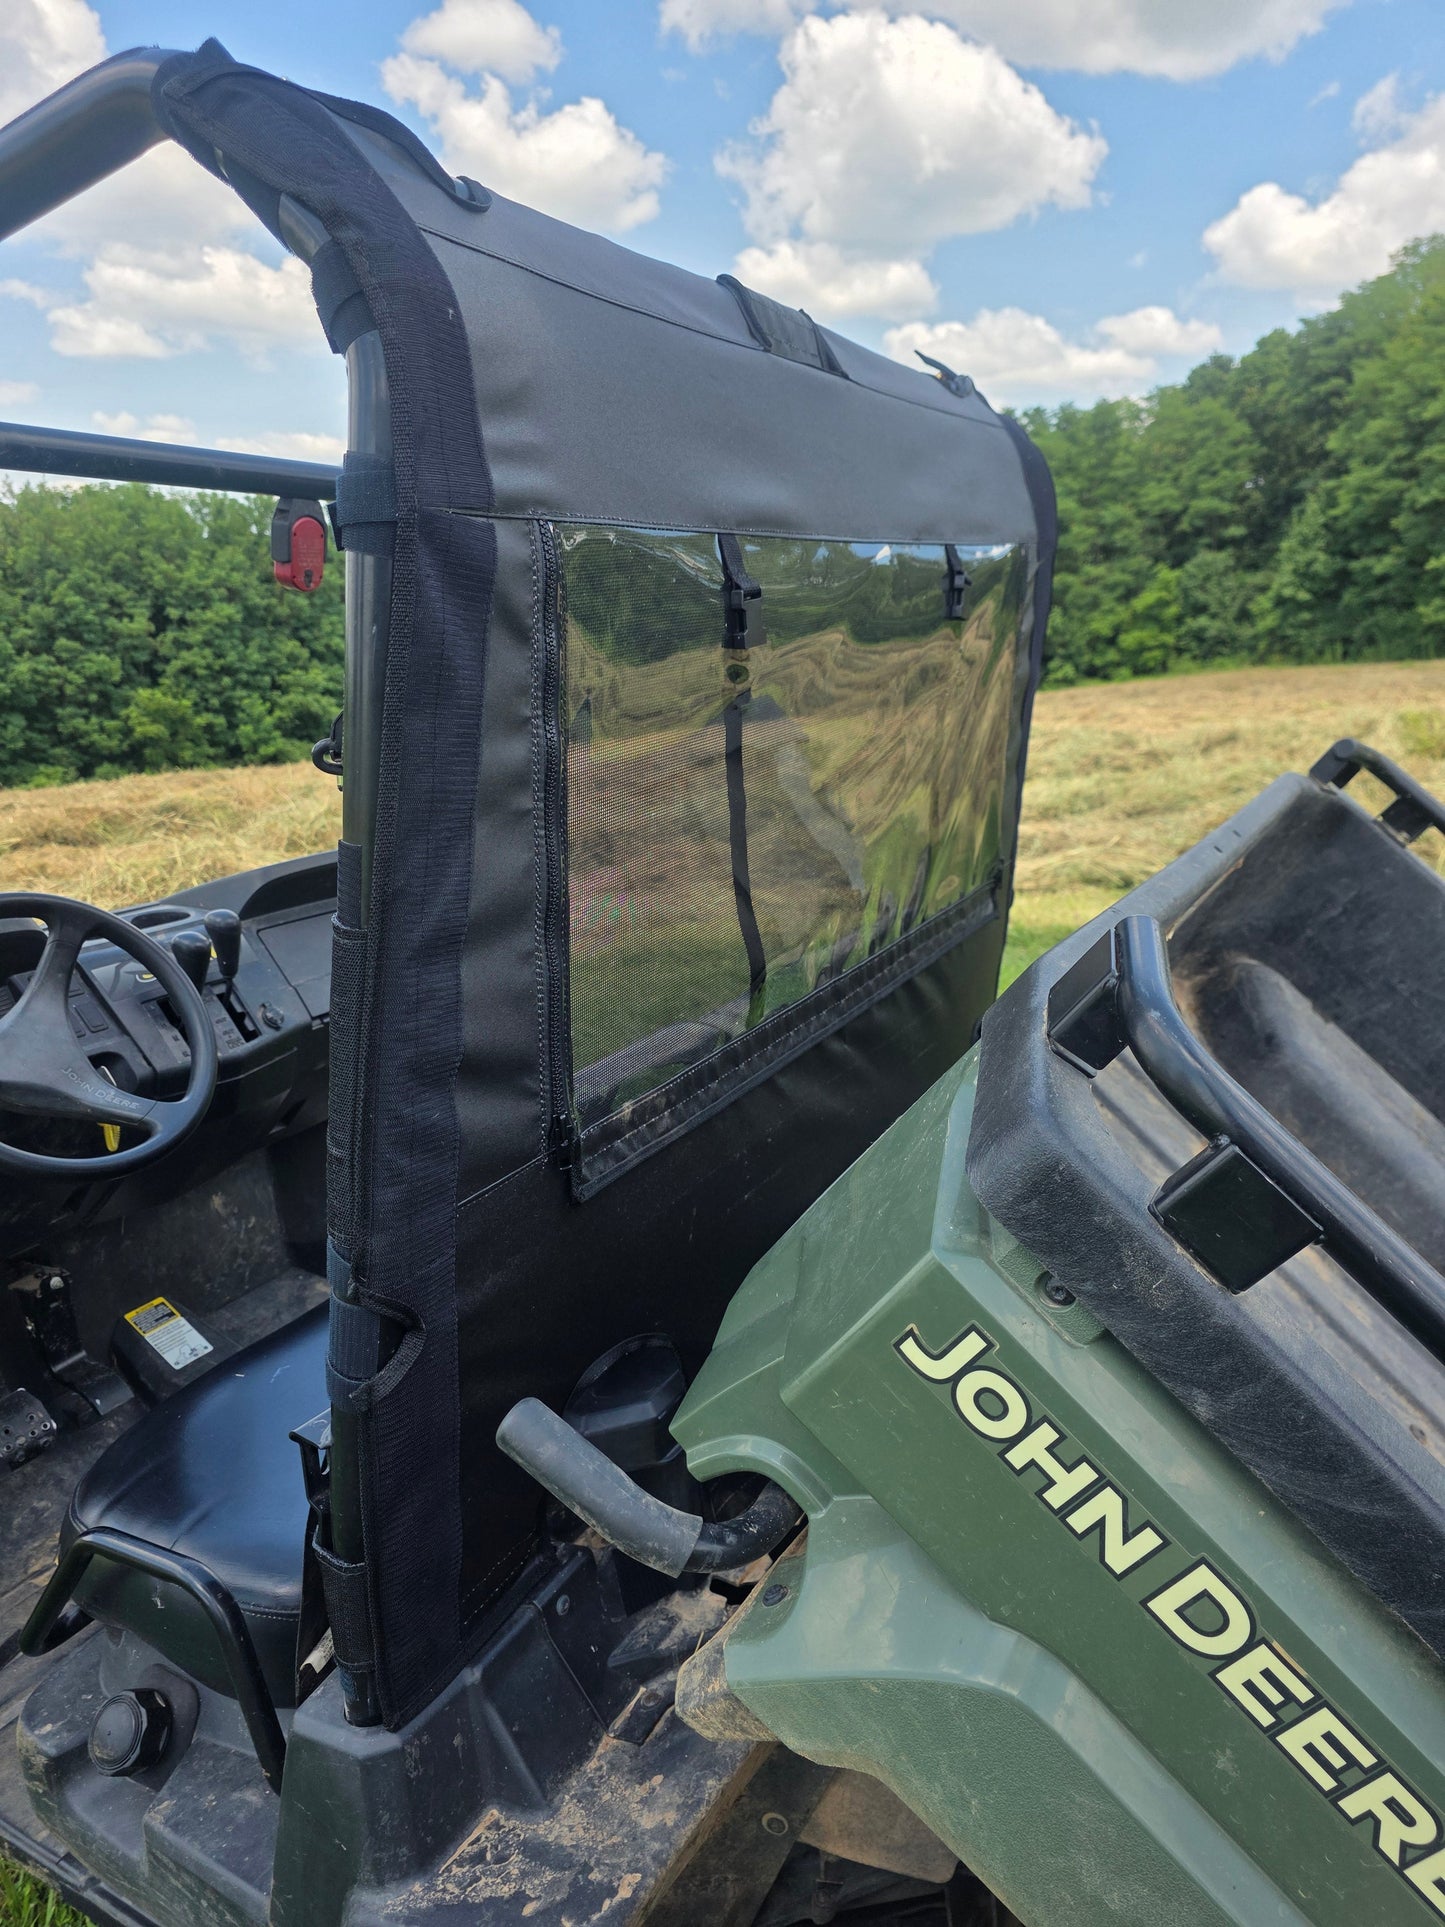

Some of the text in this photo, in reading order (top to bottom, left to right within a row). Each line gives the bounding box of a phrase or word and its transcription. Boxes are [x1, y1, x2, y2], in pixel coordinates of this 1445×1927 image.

[61, 1066, 139, 1110] JOHN DEERE
[896, 1327, 1168, 1580] JOHN
